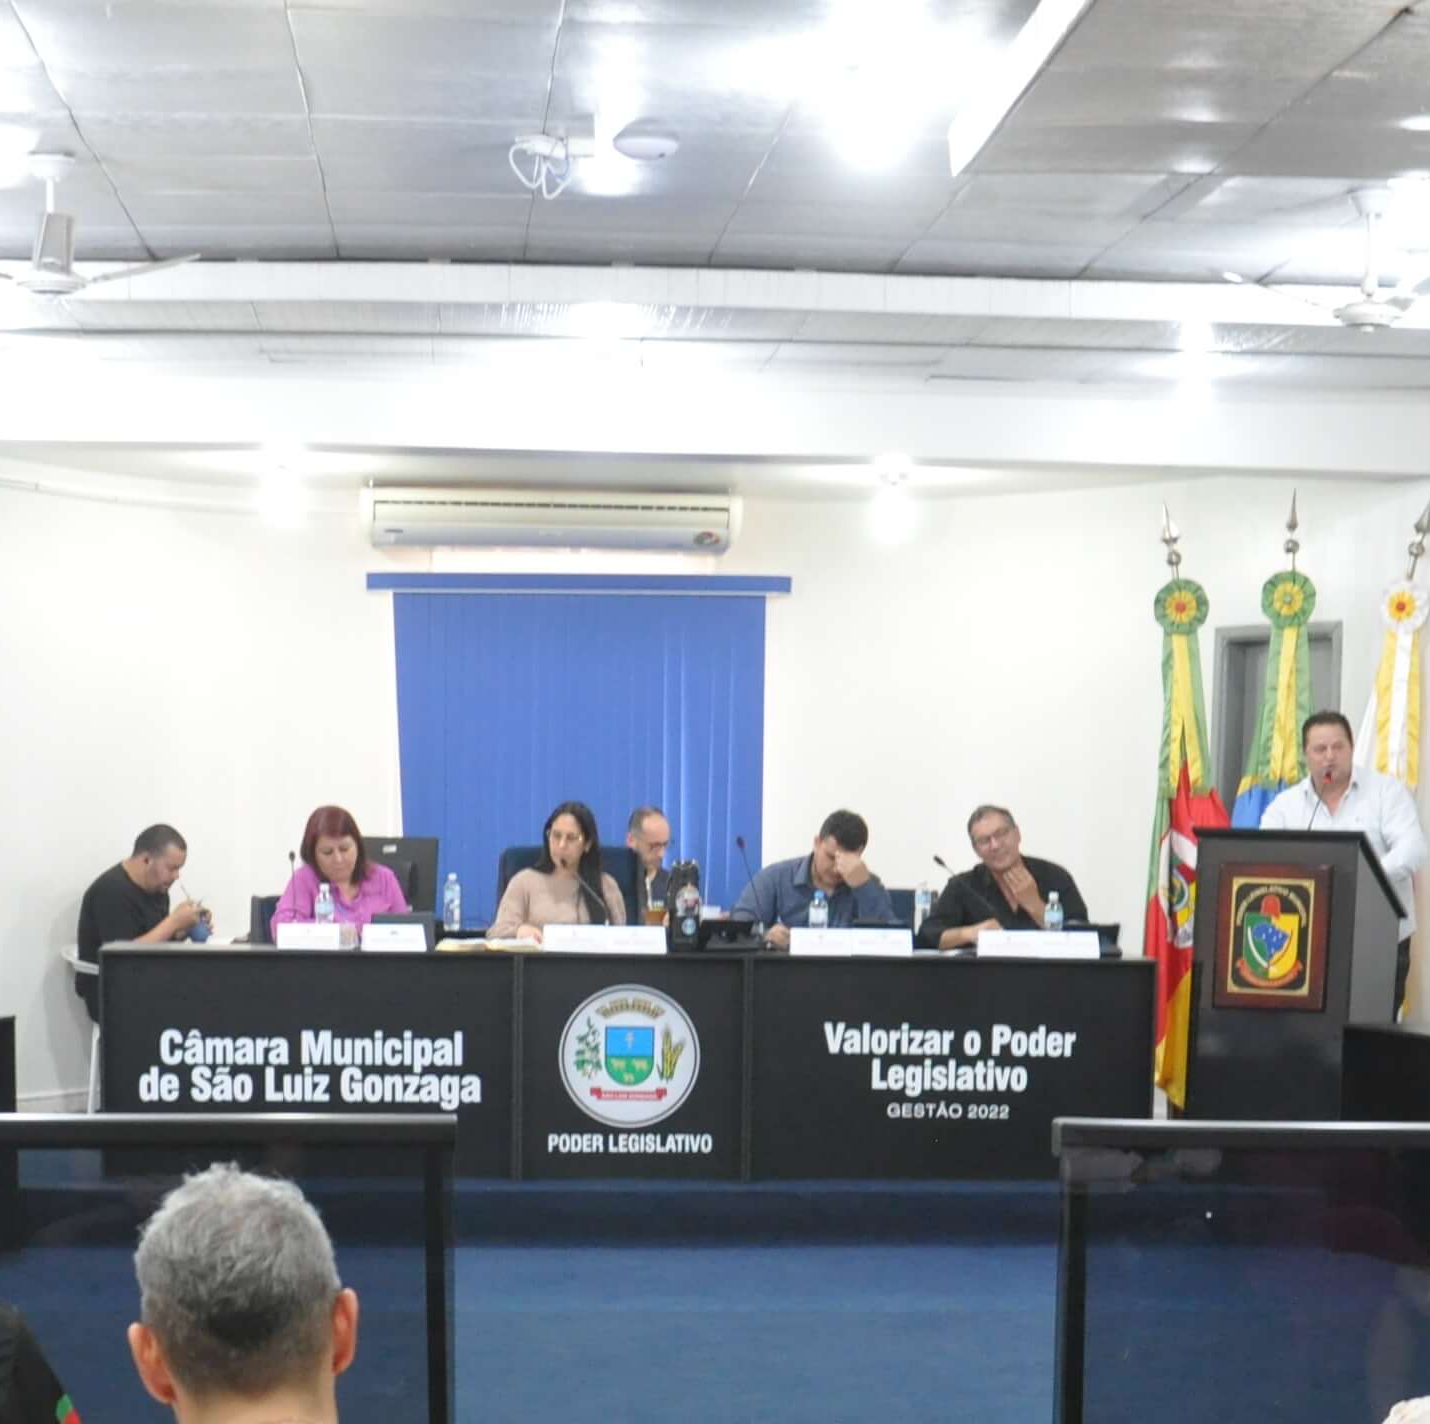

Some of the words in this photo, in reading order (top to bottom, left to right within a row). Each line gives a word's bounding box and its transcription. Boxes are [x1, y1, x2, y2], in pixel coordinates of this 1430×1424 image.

[159, 1029, 289, 1066] Câmara
[300, 1030, 463, 1073] Municipal
[823, 1022, 955, 1056] Valorizar
[963, 1030, 981, 1056] o
[990, 1024, 1077, 1058] Poder
[138, 1066, 180, 1102] de
[190, 1067, 253, 1103] São
[264, 1067, 331, 1103] Luiz
[339, 1067, 482, 1111] Gonzaga
[870, 1058, 1028, 1097] Legislativo
[886, 1101, 963, 1119] GESTÃO
[966, 1104, 1011, 1120] 2022
[547, 1132, 605, 1153] PODER
[608, 1132, 714, 1153] LEGISLATIVO
